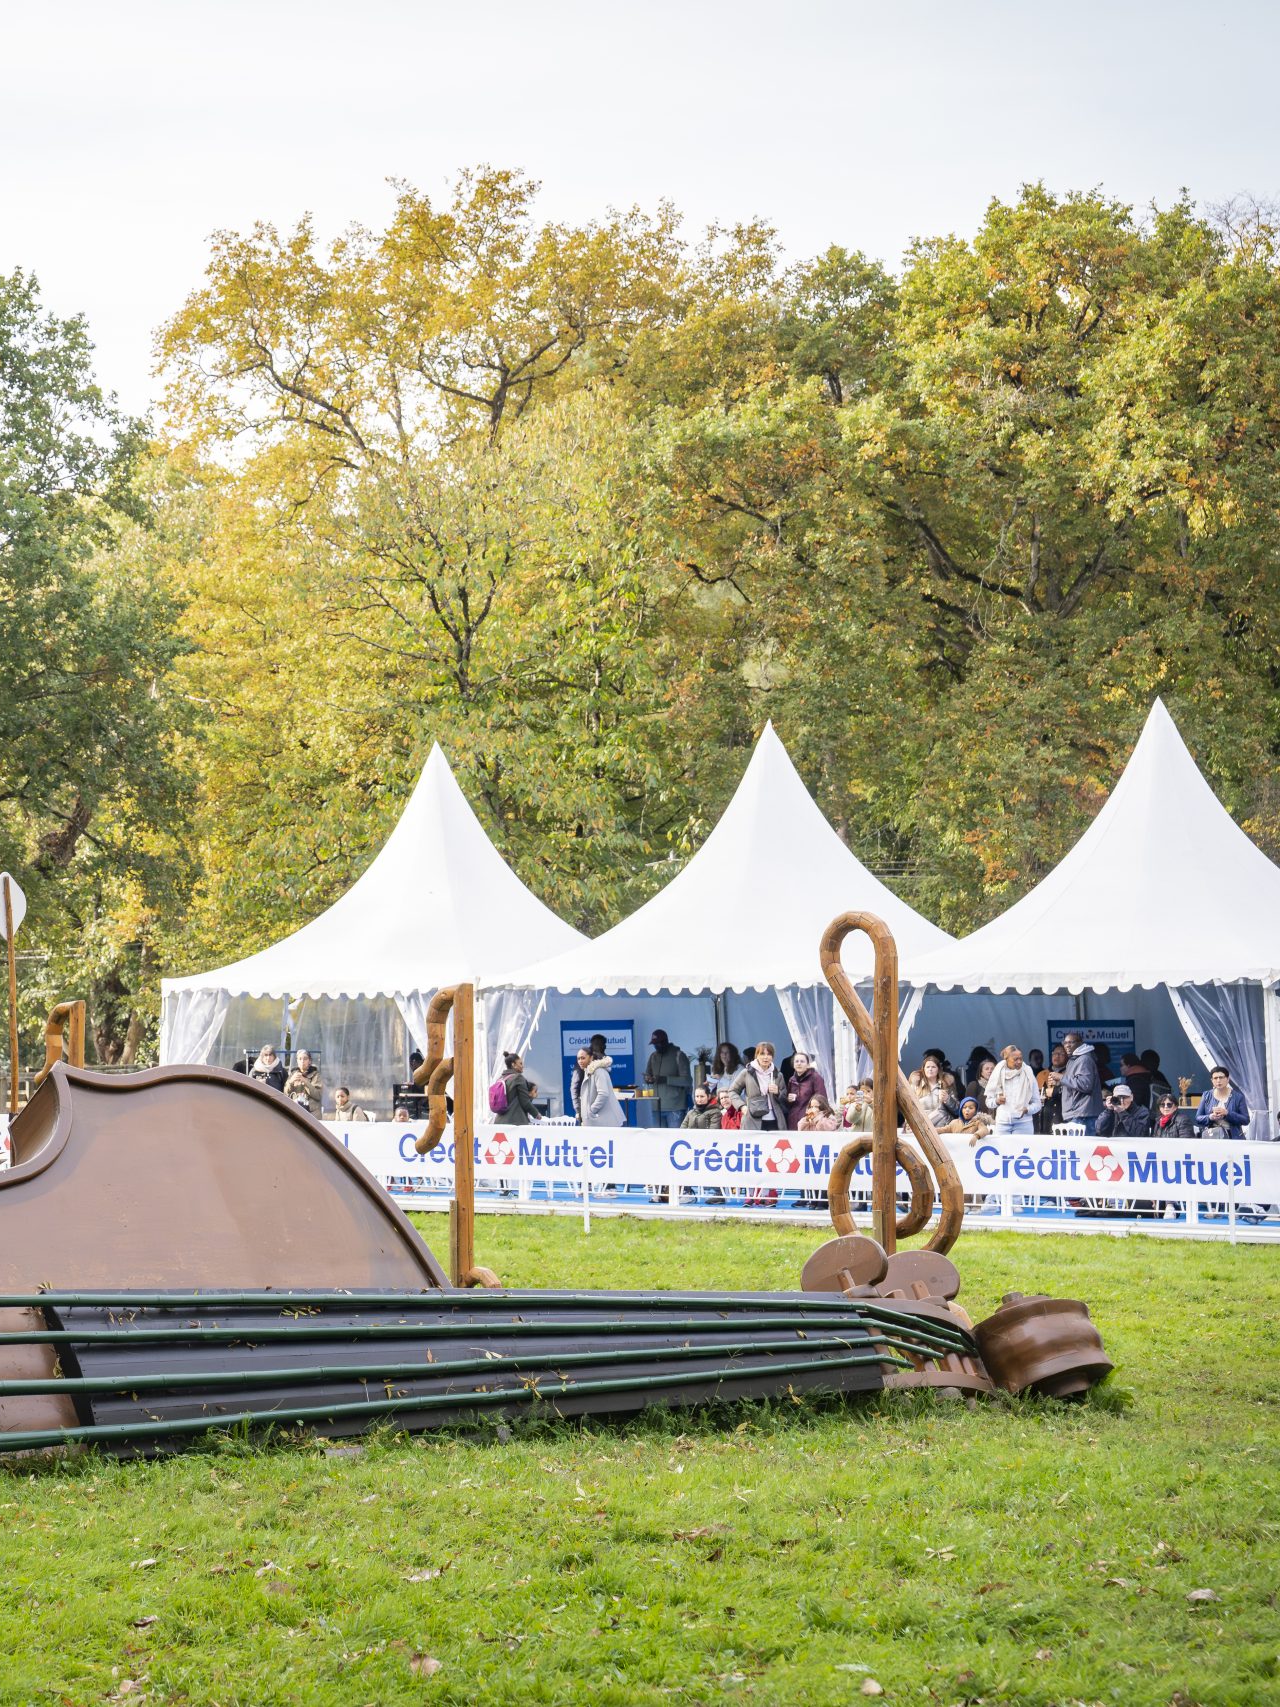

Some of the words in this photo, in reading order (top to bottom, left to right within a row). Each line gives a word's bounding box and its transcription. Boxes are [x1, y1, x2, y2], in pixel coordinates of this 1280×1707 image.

[607, 1036, 627, 1044] utuel
[1096, 1030, 1129, 1040] Mutuel
[518, 1137, 614, 1169] Mutuel
[669, 1139, 762, 1173] Crédit
[974, 1145, 1081, 1181] Crédit
[1128, 1151, 1252, 1187] Mutuel
